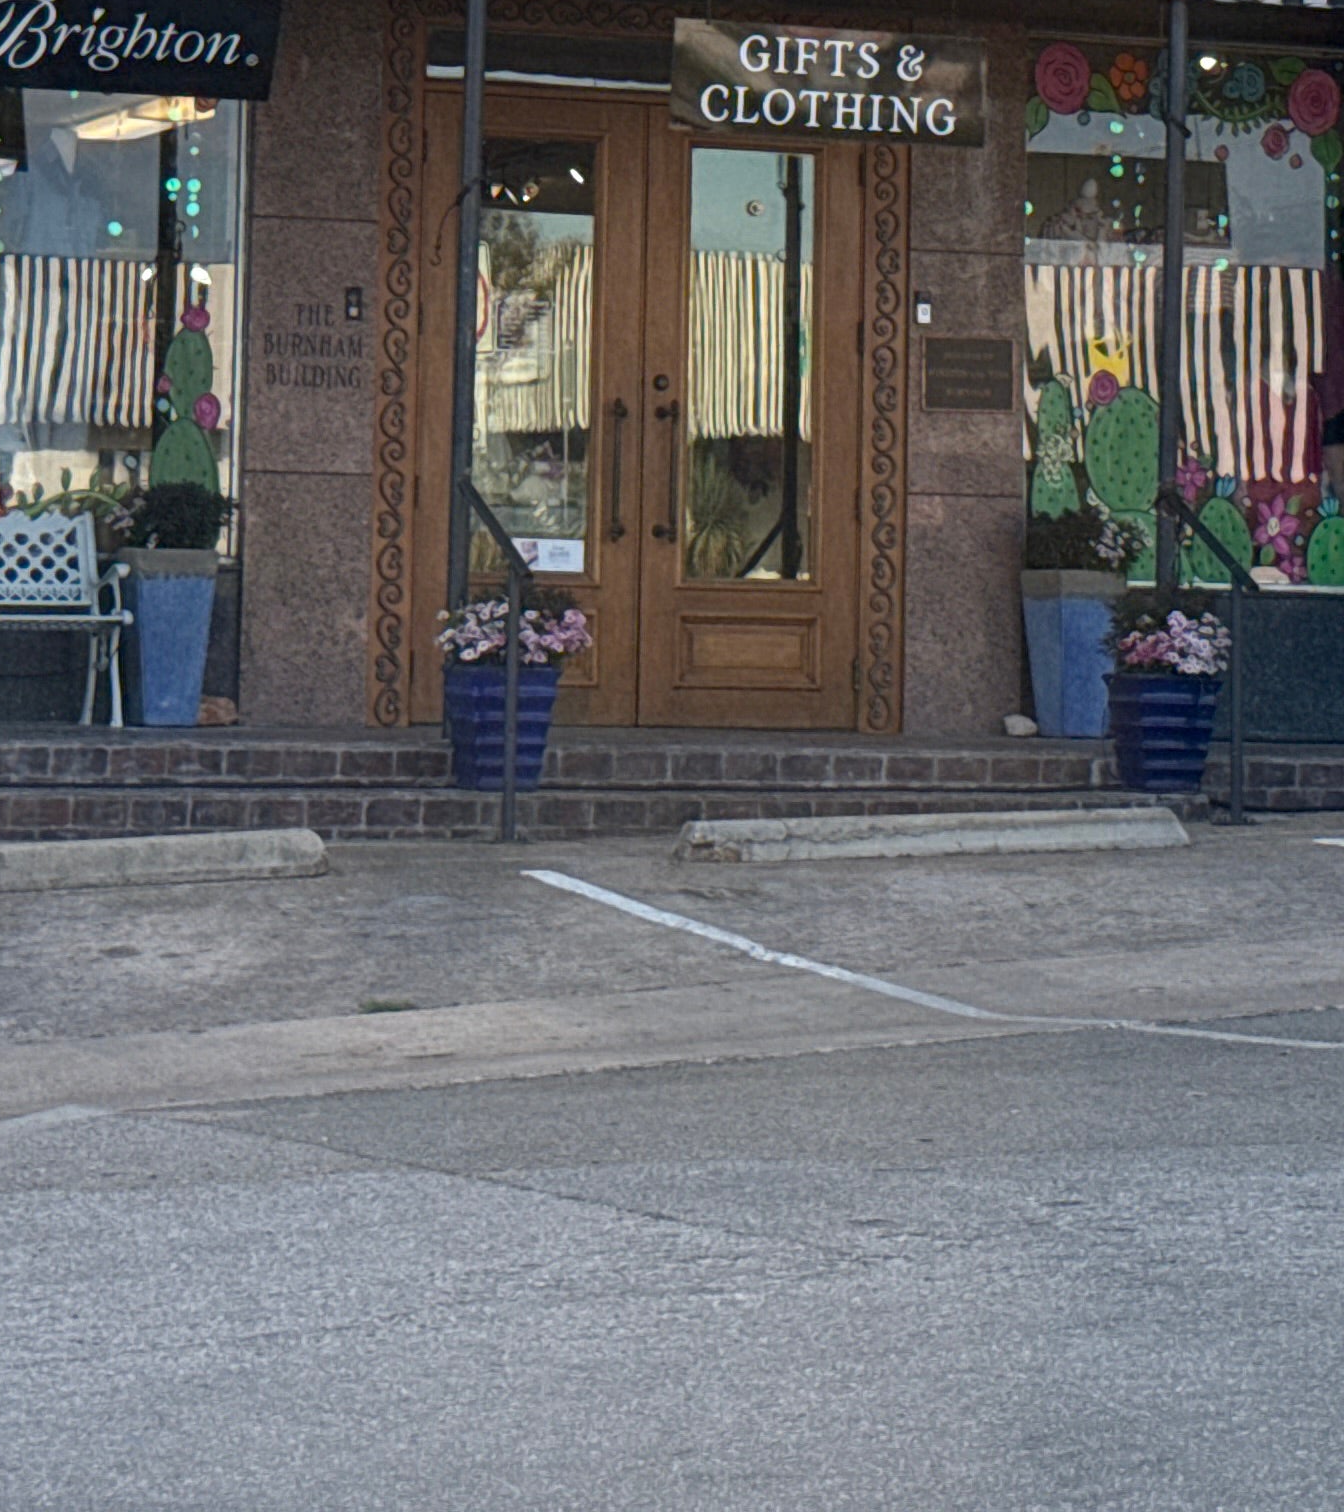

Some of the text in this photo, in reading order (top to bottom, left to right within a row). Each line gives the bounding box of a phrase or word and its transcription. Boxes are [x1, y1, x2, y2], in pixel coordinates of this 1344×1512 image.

[740, 35, 925, 82] GIFTS &
[700, 84, 957, 136] CLOTHING
[296, 304, 334, 326] THE
[264, 333, 362, 358] BURNHAM
[266, 363, 360, 389] BUILDING
